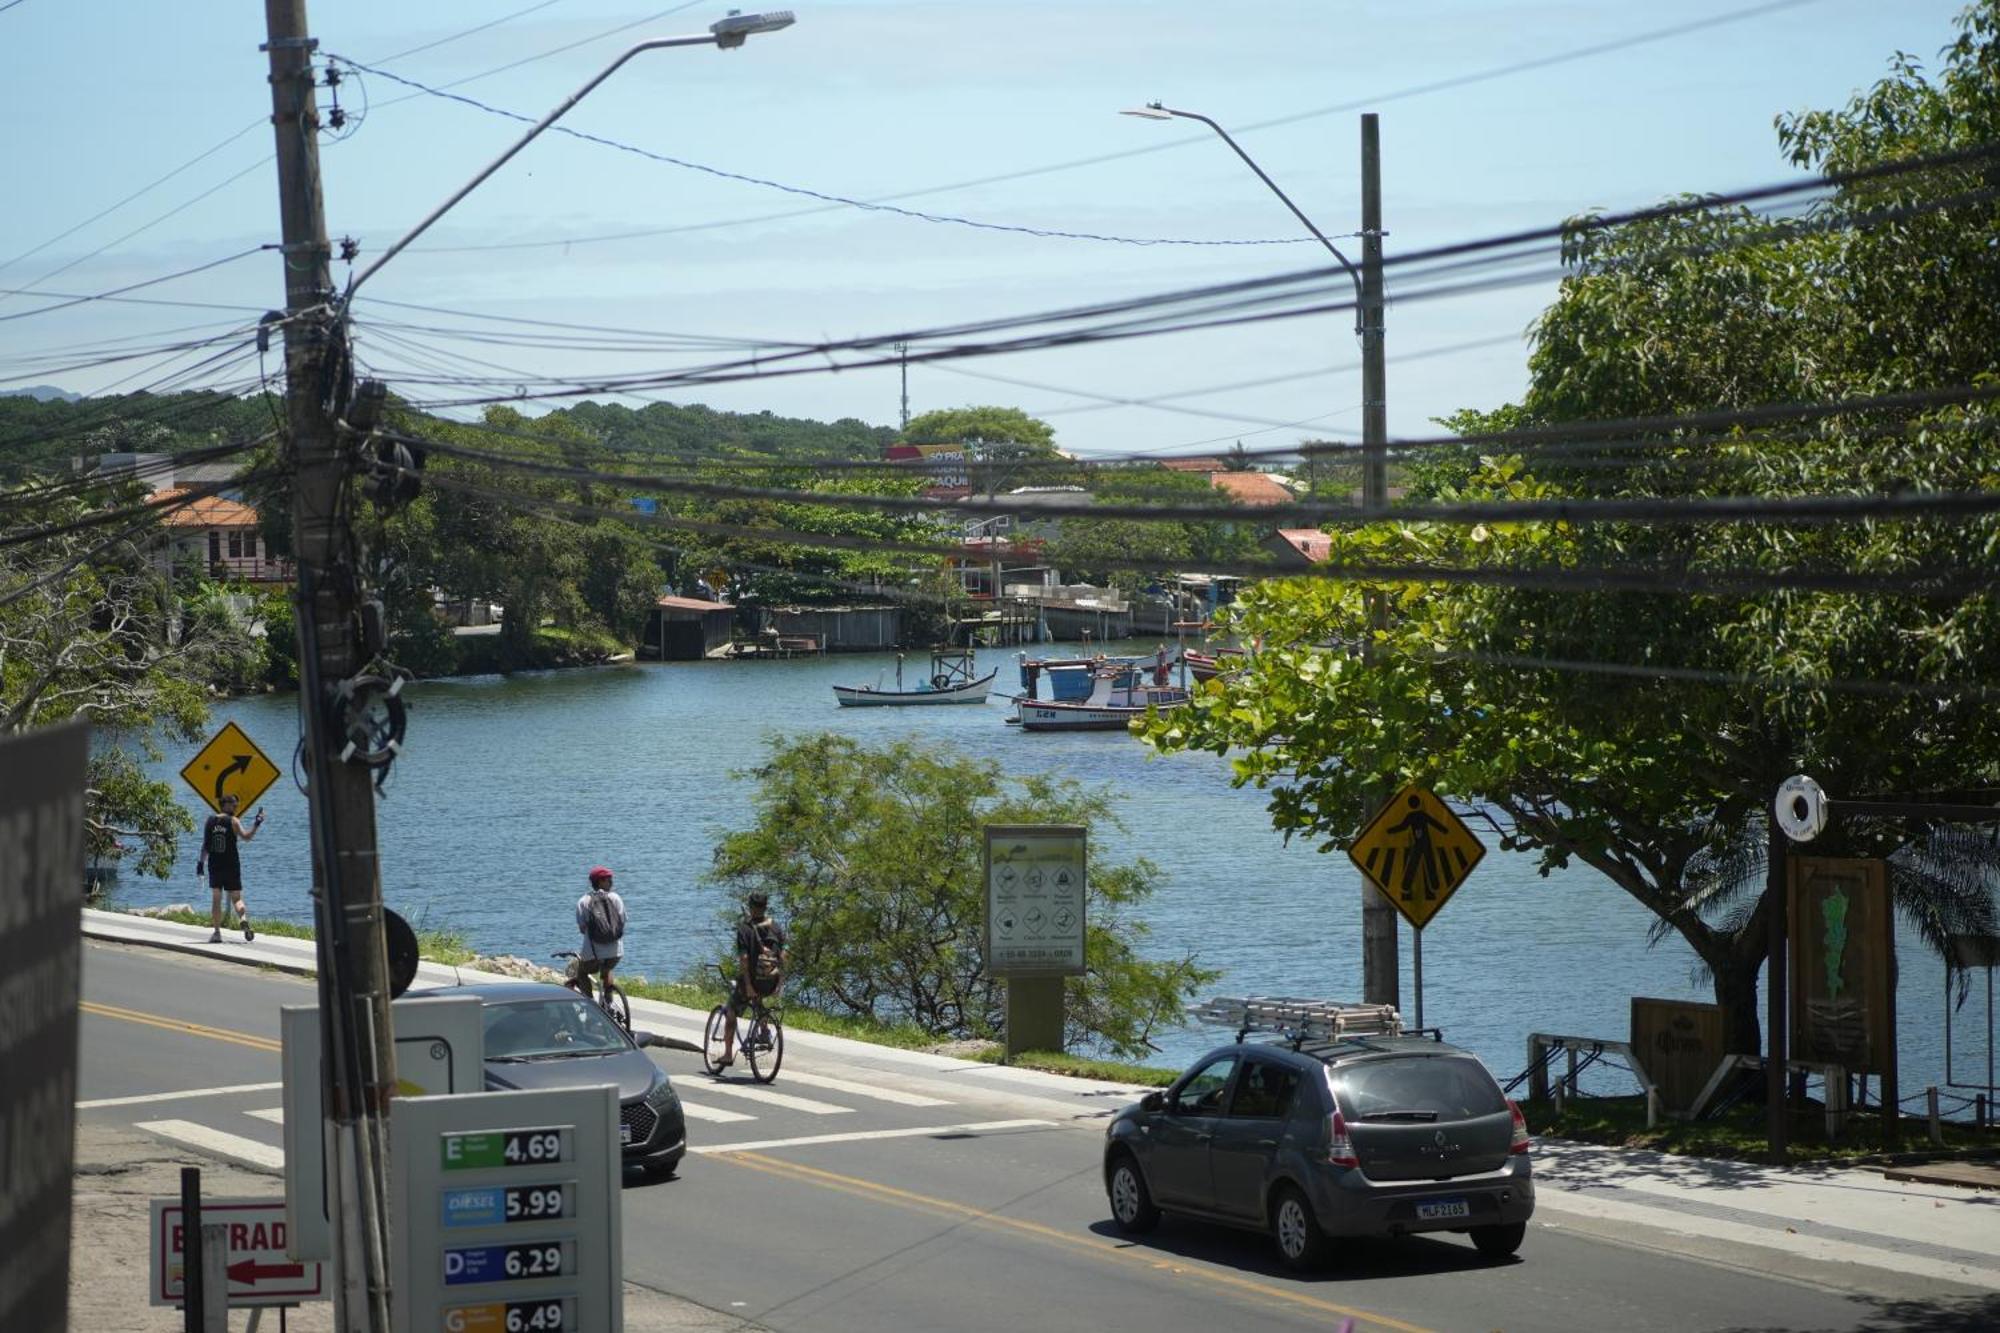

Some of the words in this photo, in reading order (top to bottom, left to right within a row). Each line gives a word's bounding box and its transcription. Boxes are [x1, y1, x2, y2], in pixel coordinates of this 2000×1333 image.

[945, 451, 964, 461] PRA
[446, 1137, 463, 1160] E
[504, 1134, 560, 1162] 4,69
[448, 1195, 496, 1210] DIESEL
[506, 1190, 562, 1217] 5,99
[445, 1252, 464, 1276] D
[504, 1247, 561, 1276] 6,29
[446, 1309, 466, 1332] G
[506, 1304, 562, 1332] 6,49
